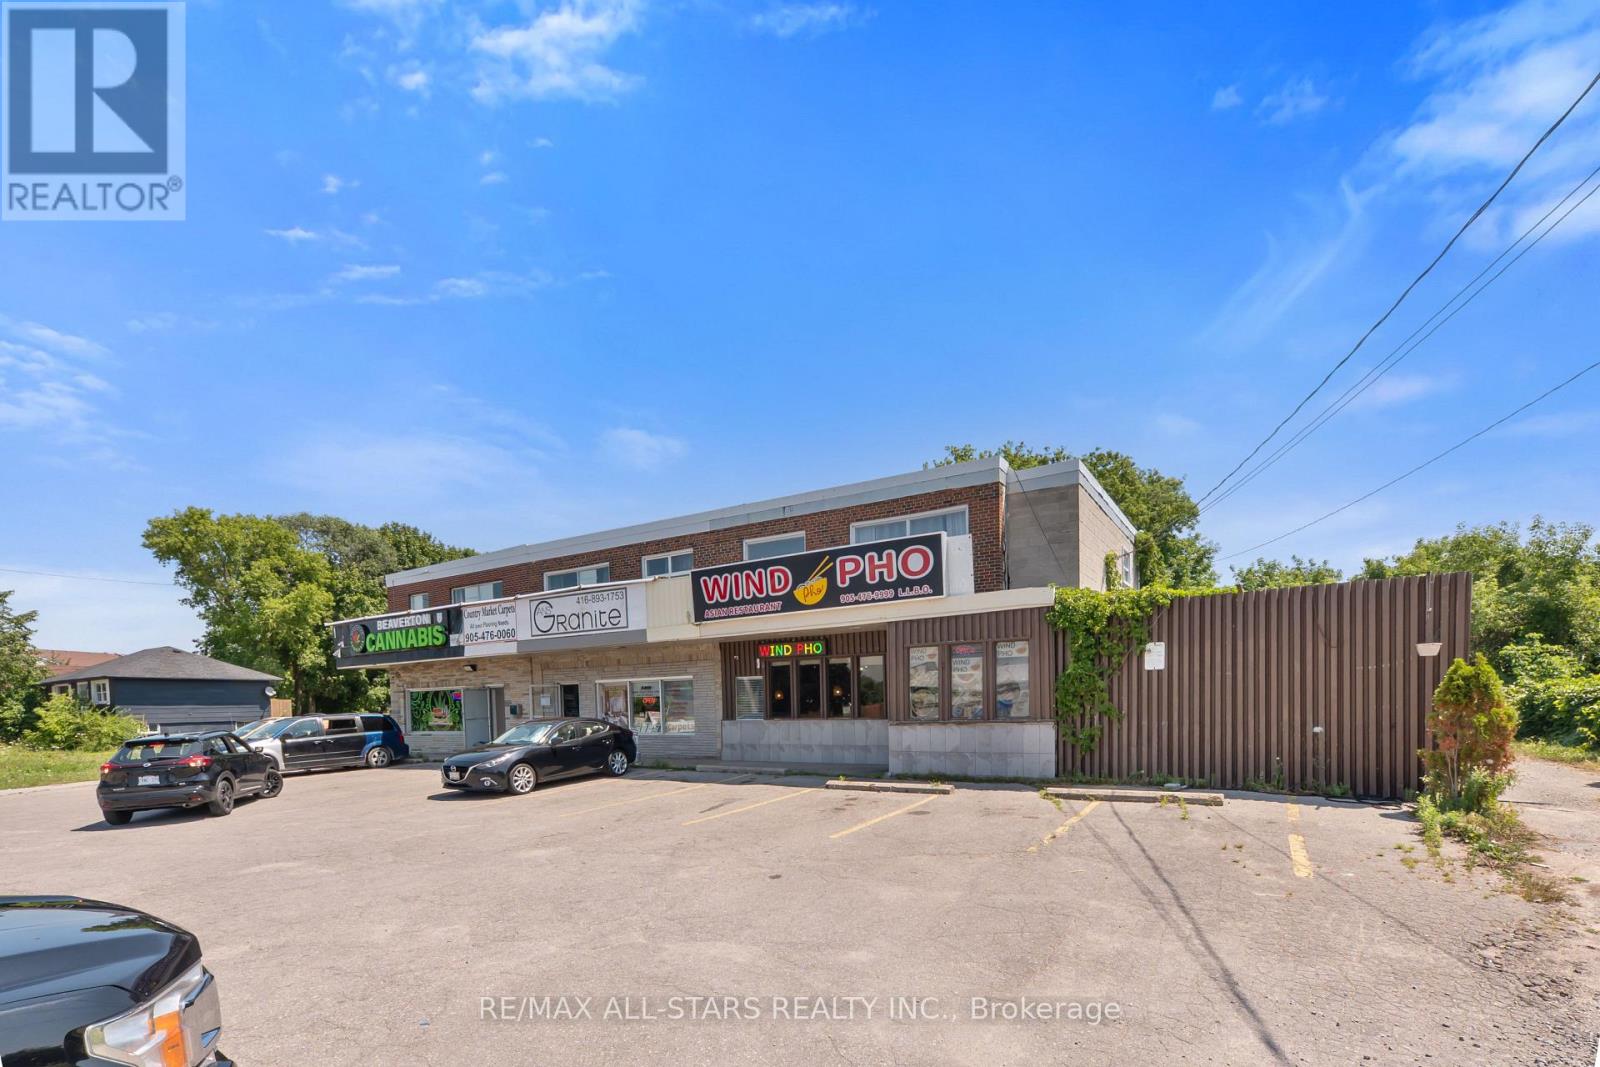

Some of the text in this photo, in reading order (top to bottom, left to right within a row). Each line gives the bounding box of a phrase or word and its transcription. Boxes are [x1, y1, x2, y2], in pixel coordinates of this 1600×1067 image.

[700, 545, 934, 604] WIND PHO
[576, 591, 624, 604] 416-893-1753
[898, 585, 933, 597] L.L.B.O.
[463, 609, 481, 620] Country
[481, 605, 498, 617] Market
[704, 601, 783, 619] ASIAN RESTAURANT
[377, 614, 432, 630] BEAVERTON
[366, 625, 447, 652] CANNABIS
[466, 628, 516, 642] 905-476-0060
[759, 642, 823, 657] WIND PHO
